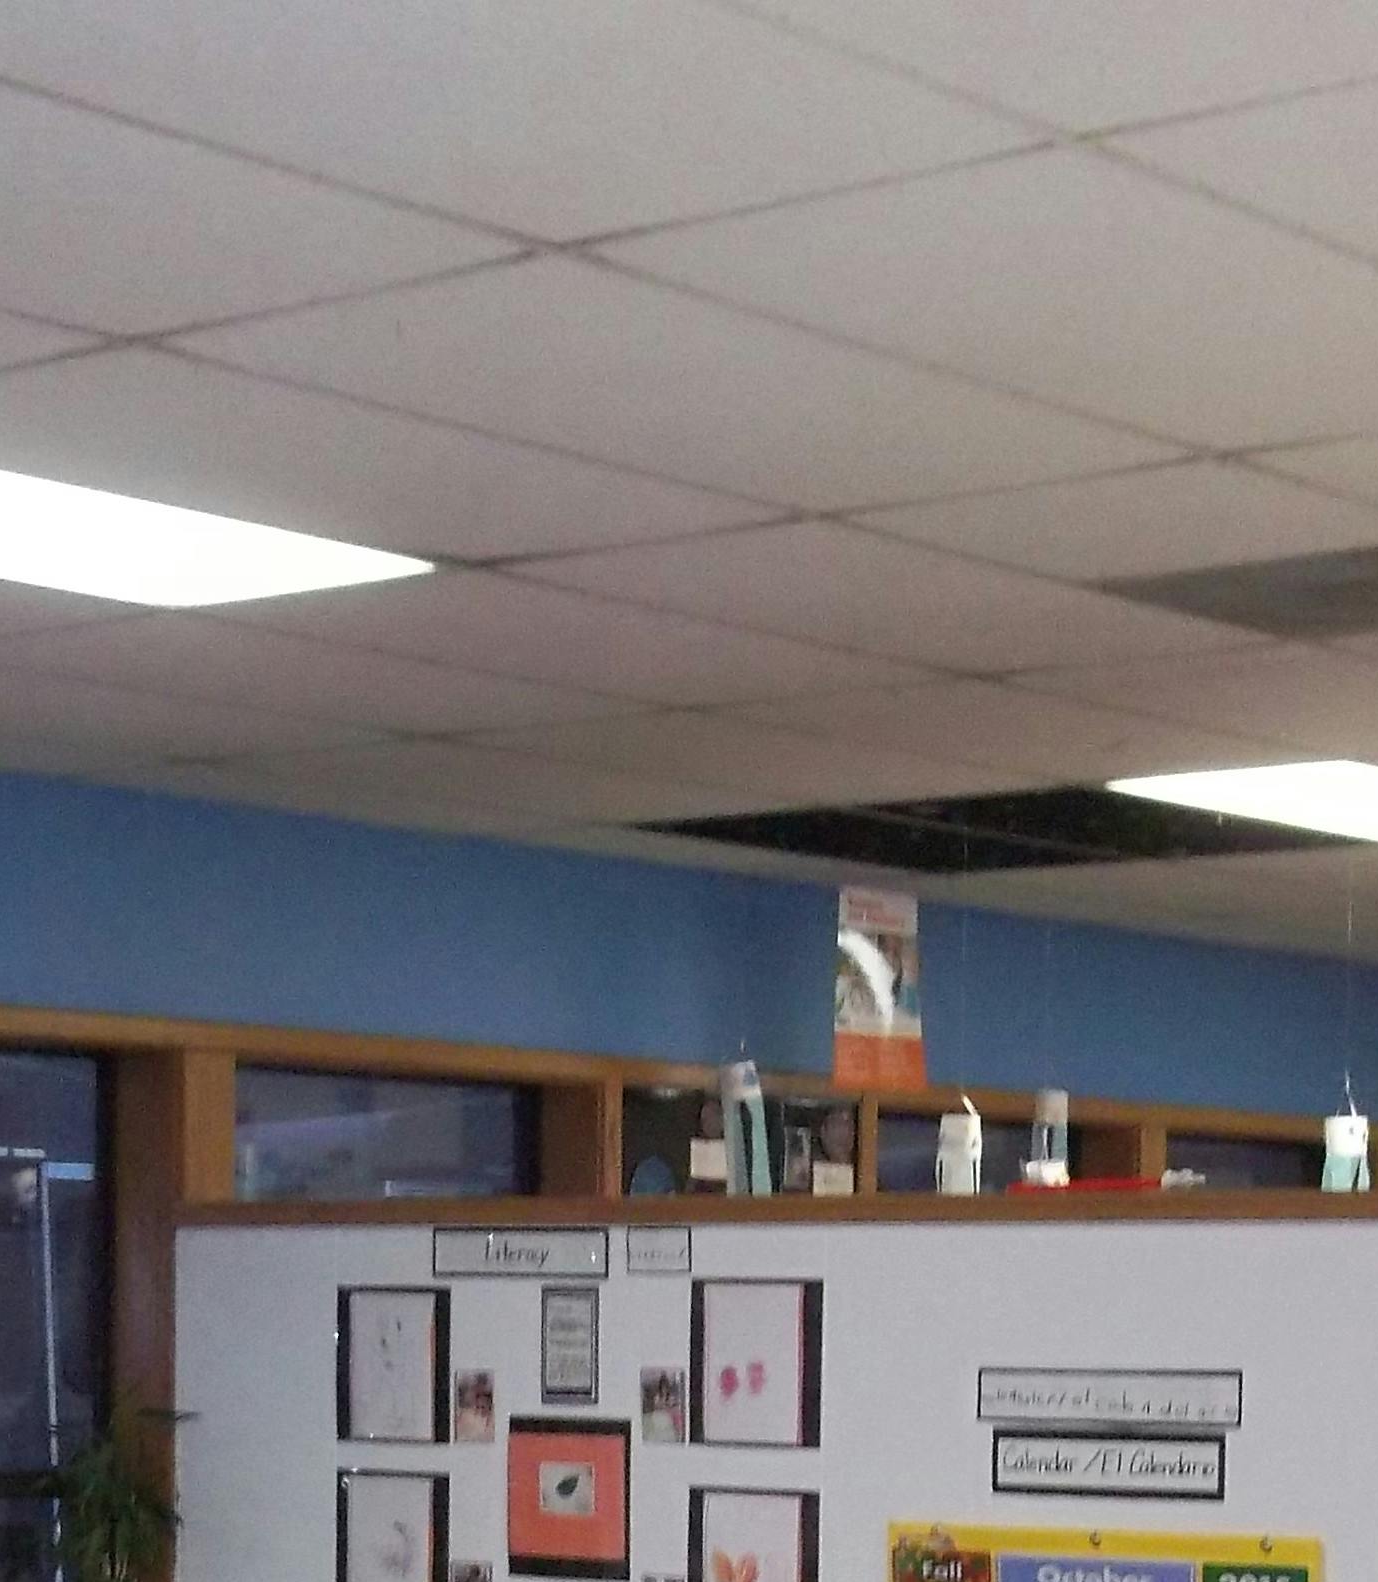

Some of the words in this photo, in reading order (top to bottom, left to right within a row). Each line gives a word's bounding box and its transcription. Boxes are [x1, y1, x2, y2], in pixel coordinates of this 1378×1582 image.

[485, 1238, 550, 1267] Literacy
[1002, 1442, 1074, 1474] Calendar
[1129, 1446, 1216, 1476] Calendario
[923, 1560, 963, 1582] Fall
